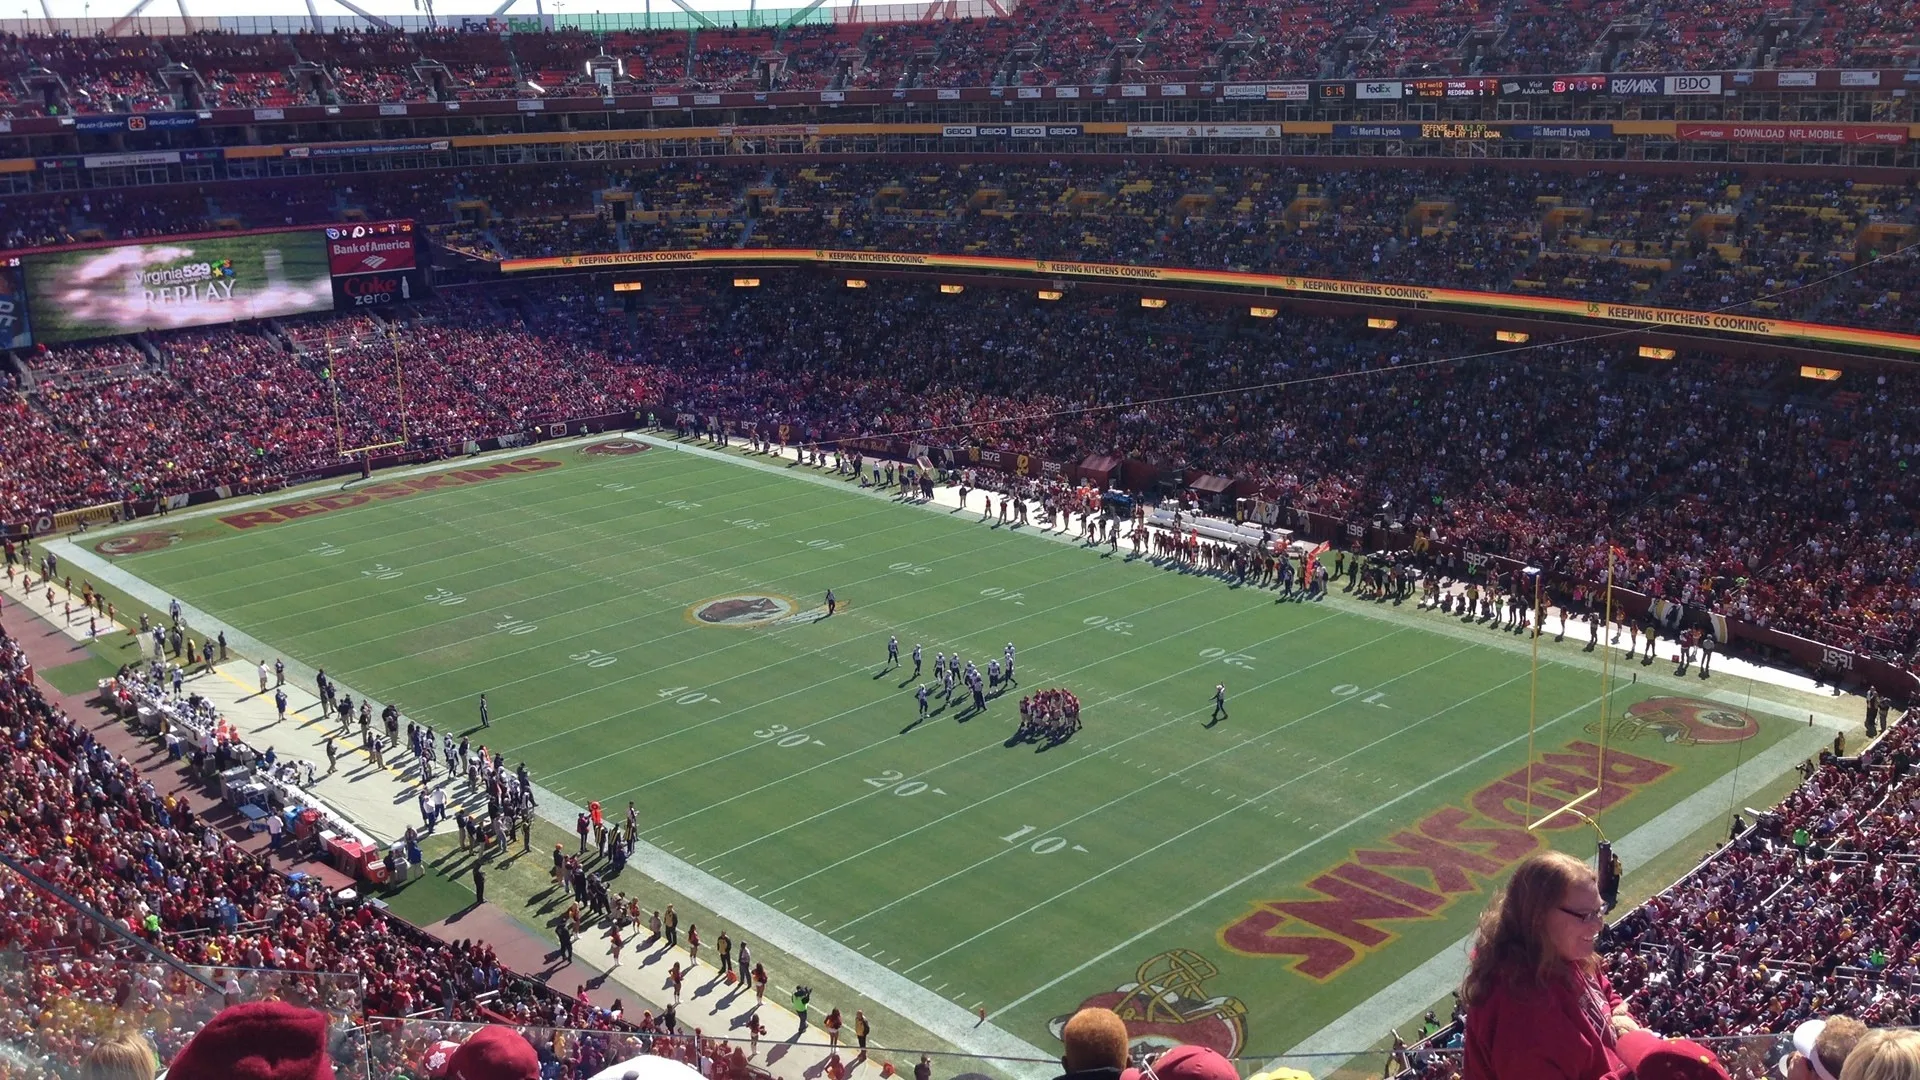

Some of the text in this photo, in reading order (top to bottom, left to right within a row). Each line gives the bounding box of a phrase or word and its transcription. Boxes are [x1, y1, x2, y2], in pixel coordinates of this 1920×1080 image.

[1225, 85, 1258, 96] Carpetland
[1366, 83, 1391, 94] FedEx
[1611, 79, 1658, 94] RE/MAX
[1678, 78, 1710, 90] BDO
[131, 118, 143, 128] 25
[1359, 127, 1380, 136] Merrill
[1381, 127, 1401, 138] Lynch
[1543, 127, 1567, 137] Merrill
[1568, 127, 1591, 138] Lynch
[1700, 129, 1723, 137] verizon
[1733, 128, 1785, 139] DOWNLOAD
[1789, 129, 1806, 139] NFL
[1876, 133, 1903, 141] verizon
[333, 240, 411, 255] Bank of America
[578, 256, 612, 265] KEEPING
[614, 254, 653, 263] KITCHENS
[828, 252, 857, 261] KEEPING
[858, 253, 890, 263] KITCHENS
[1052, 264, 1082, 273] KEEPING
[1084, 265, 1118, 276] KITCHENS
[143, 278, 236, 305] REPLAY
[343, 276, 397, 297] Coke
[1302, 280, 1338, 292] KEEPING
[1340, 282, 1382, 296] KITCHENS
[354, 292, 390, 305] zero
[1608, 306, 1653, 321] KEEPING
[1656, 310, 1710, 326] KITCHENS
[552, 426, 565, 434] 25
[981, 450, 1000, 462] 1972
[1042, 460, 1062, 472] 1982
[216, 457, 565, 531] REDSKINS
[1346, 523, 1364, 538] 198
[1463, 551, 1489, 567] 1987
[568, 649, 618, 668] 50
[1199, 647, 1252, 668] 20
[1822, 648, 1853, 670] 1991
[656, 685, 708, 705] 40
[1330, 684, 1385, 706] 10
[752, 724, 810, 748] 30
[863, 769, 928, 797] 20
[999, 824, 1068, 855] 10
[1218, 740, 1681, 983] REDSKINS
